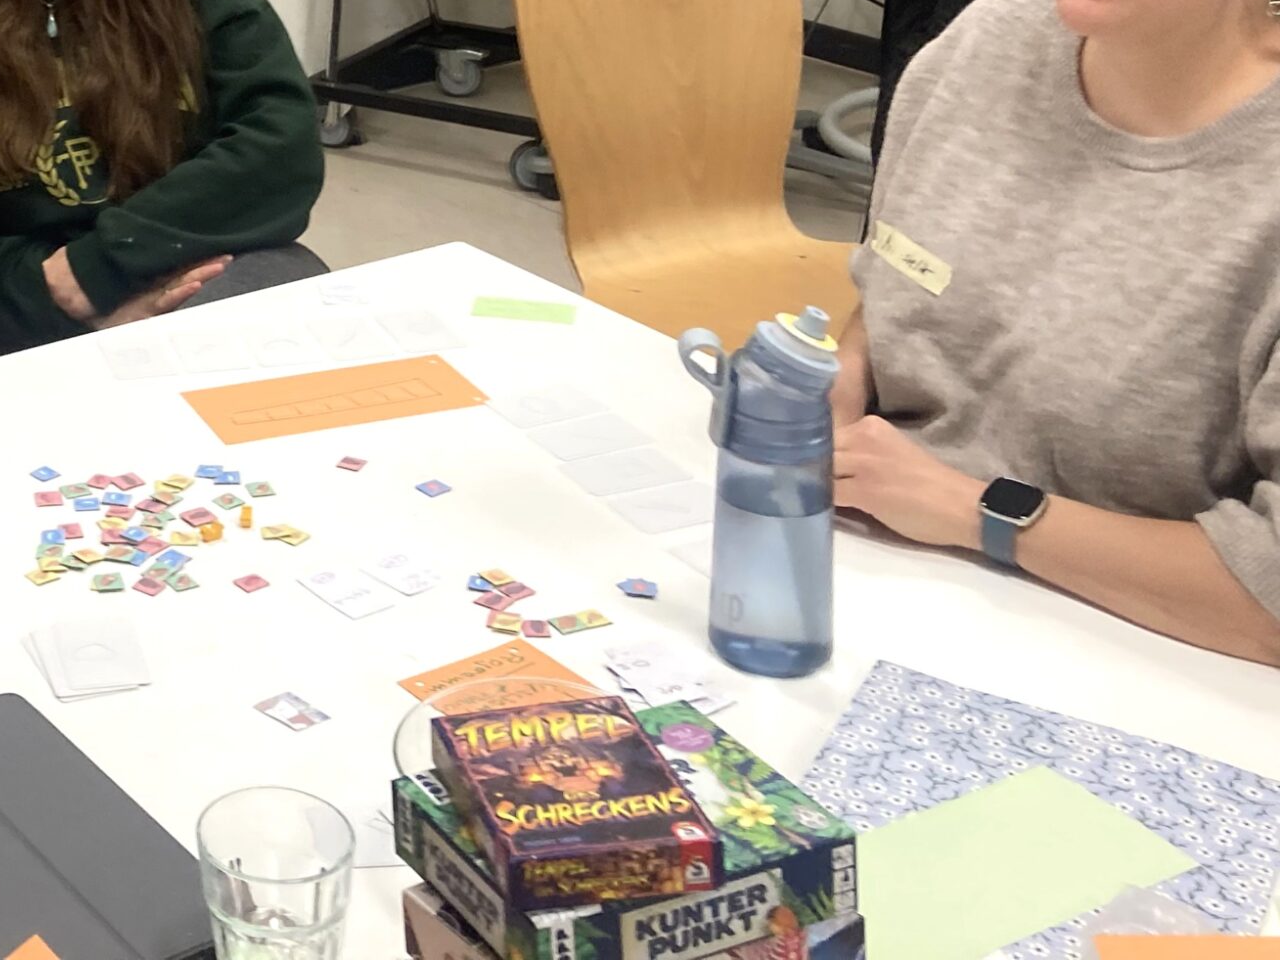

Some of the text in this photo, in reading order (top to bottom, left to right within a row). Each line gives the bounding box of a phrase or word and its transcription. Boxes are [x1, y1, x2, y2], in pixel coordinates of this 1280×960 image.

[455, 713, 634, 755] TEMPEL
[496, 788, 693, 833] SCHRECKENS
[635, 883, 767, 941] KUNTER
[648, 909, 757, 959] PUNKT
